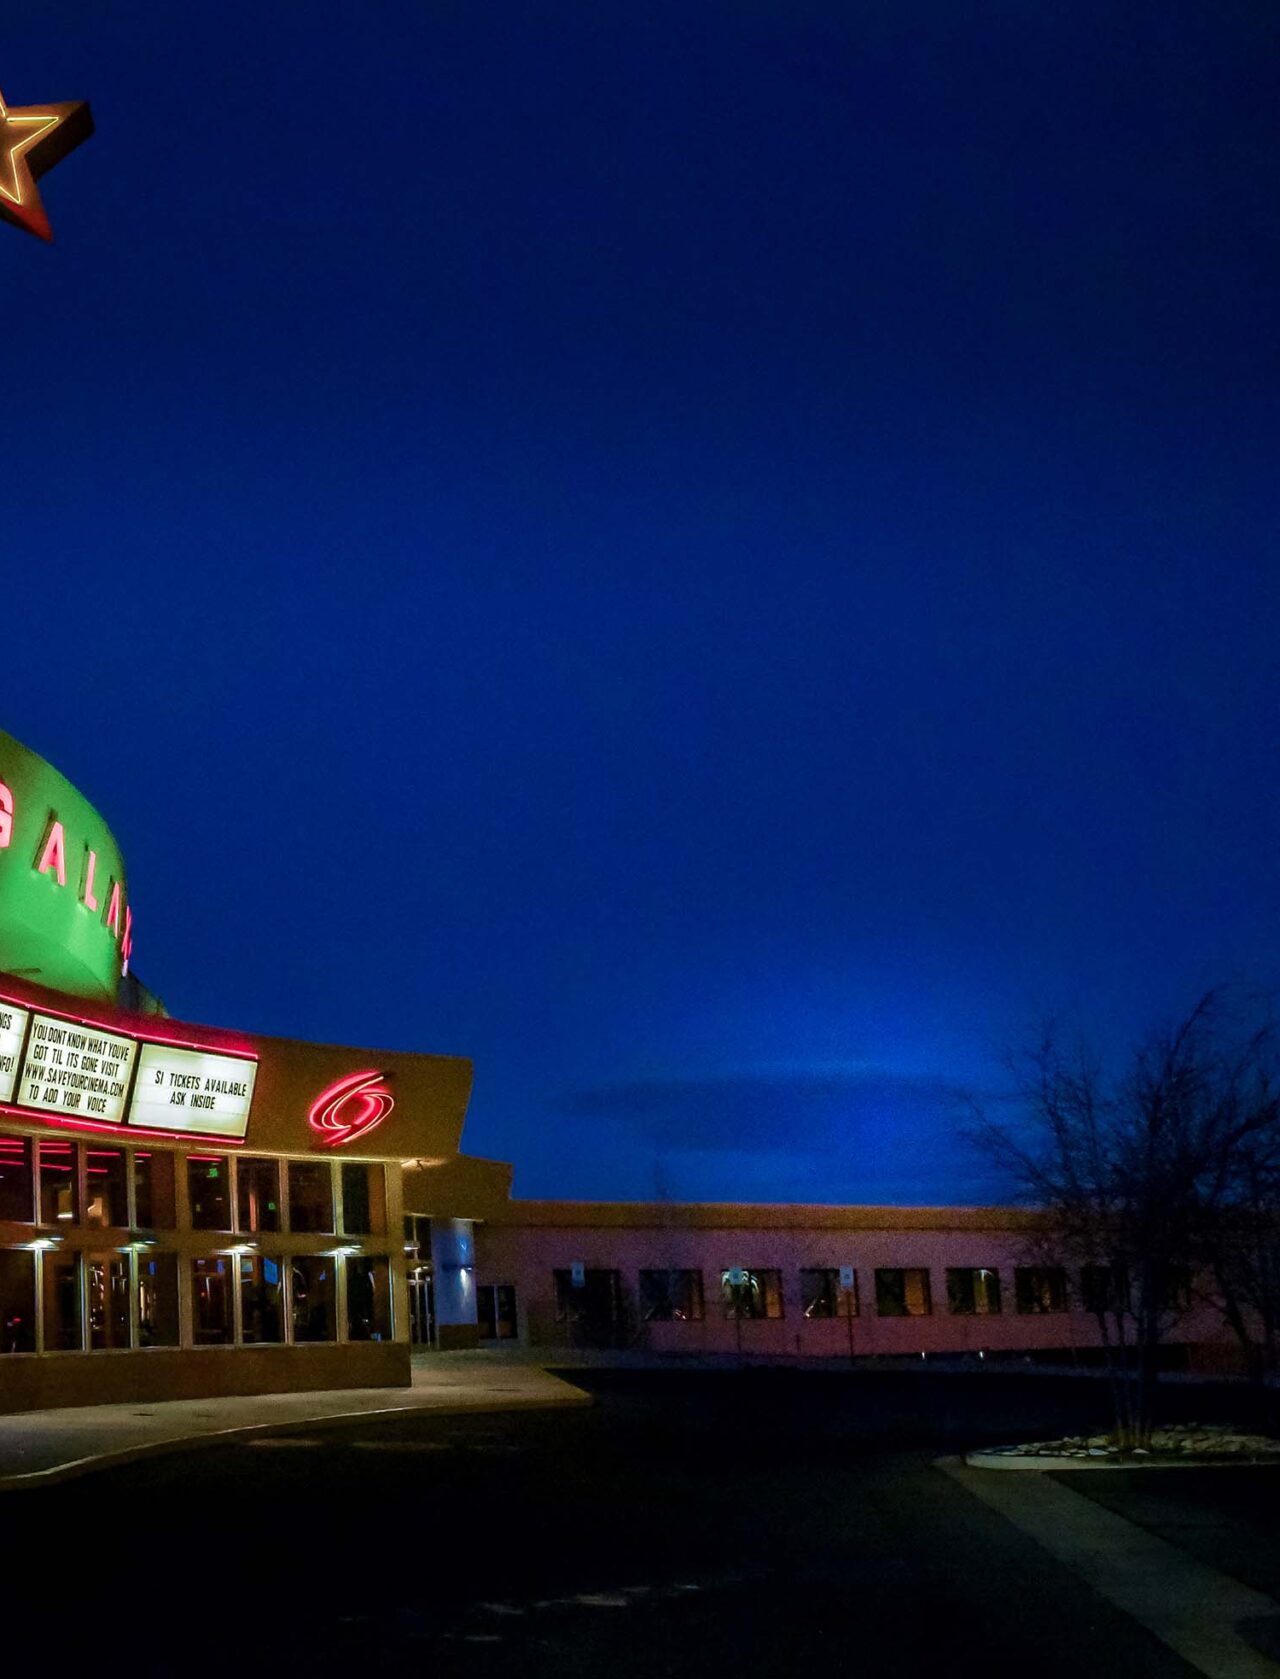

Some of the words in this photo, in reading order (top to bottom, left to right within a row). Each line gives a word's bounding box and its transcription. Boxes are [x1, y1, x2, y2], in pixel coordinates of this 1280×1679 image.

[32, 1023, 48, 1040] YOU
[48, 1027, 67, 1045] DONT
[66, 1032, 88, 1050] KNOW
[87, 1037, 108, 1055] WHAT
[108, 1042, 129, 1061] YOUVE
[33, 1044, 49, 1061] GOT
[52, 1048, 63, 1065] TIL
[66, 1052, 79, 1068] ITS
[81, 1056, 99, 1073] GONE
[101, 1061, 120, 1078] VISIT
[24, 1063, 125, 1098] WWW.SAVEYOURCINEMA.COM
[169, 1073, 201, 1090] TICKETS
[204, 1078, 247, 1097] AVAILABLE
[29, 1084, 40, 1100] TO
[42, 1087, 58, 1103] ADD
[63, 1091, 81, 1108] YOUR
[87, 1095, 107, 1113] VOICE
[170, 1091, 186, 1106] ASK
[190, 1094, 216, 1109] INSIDE
